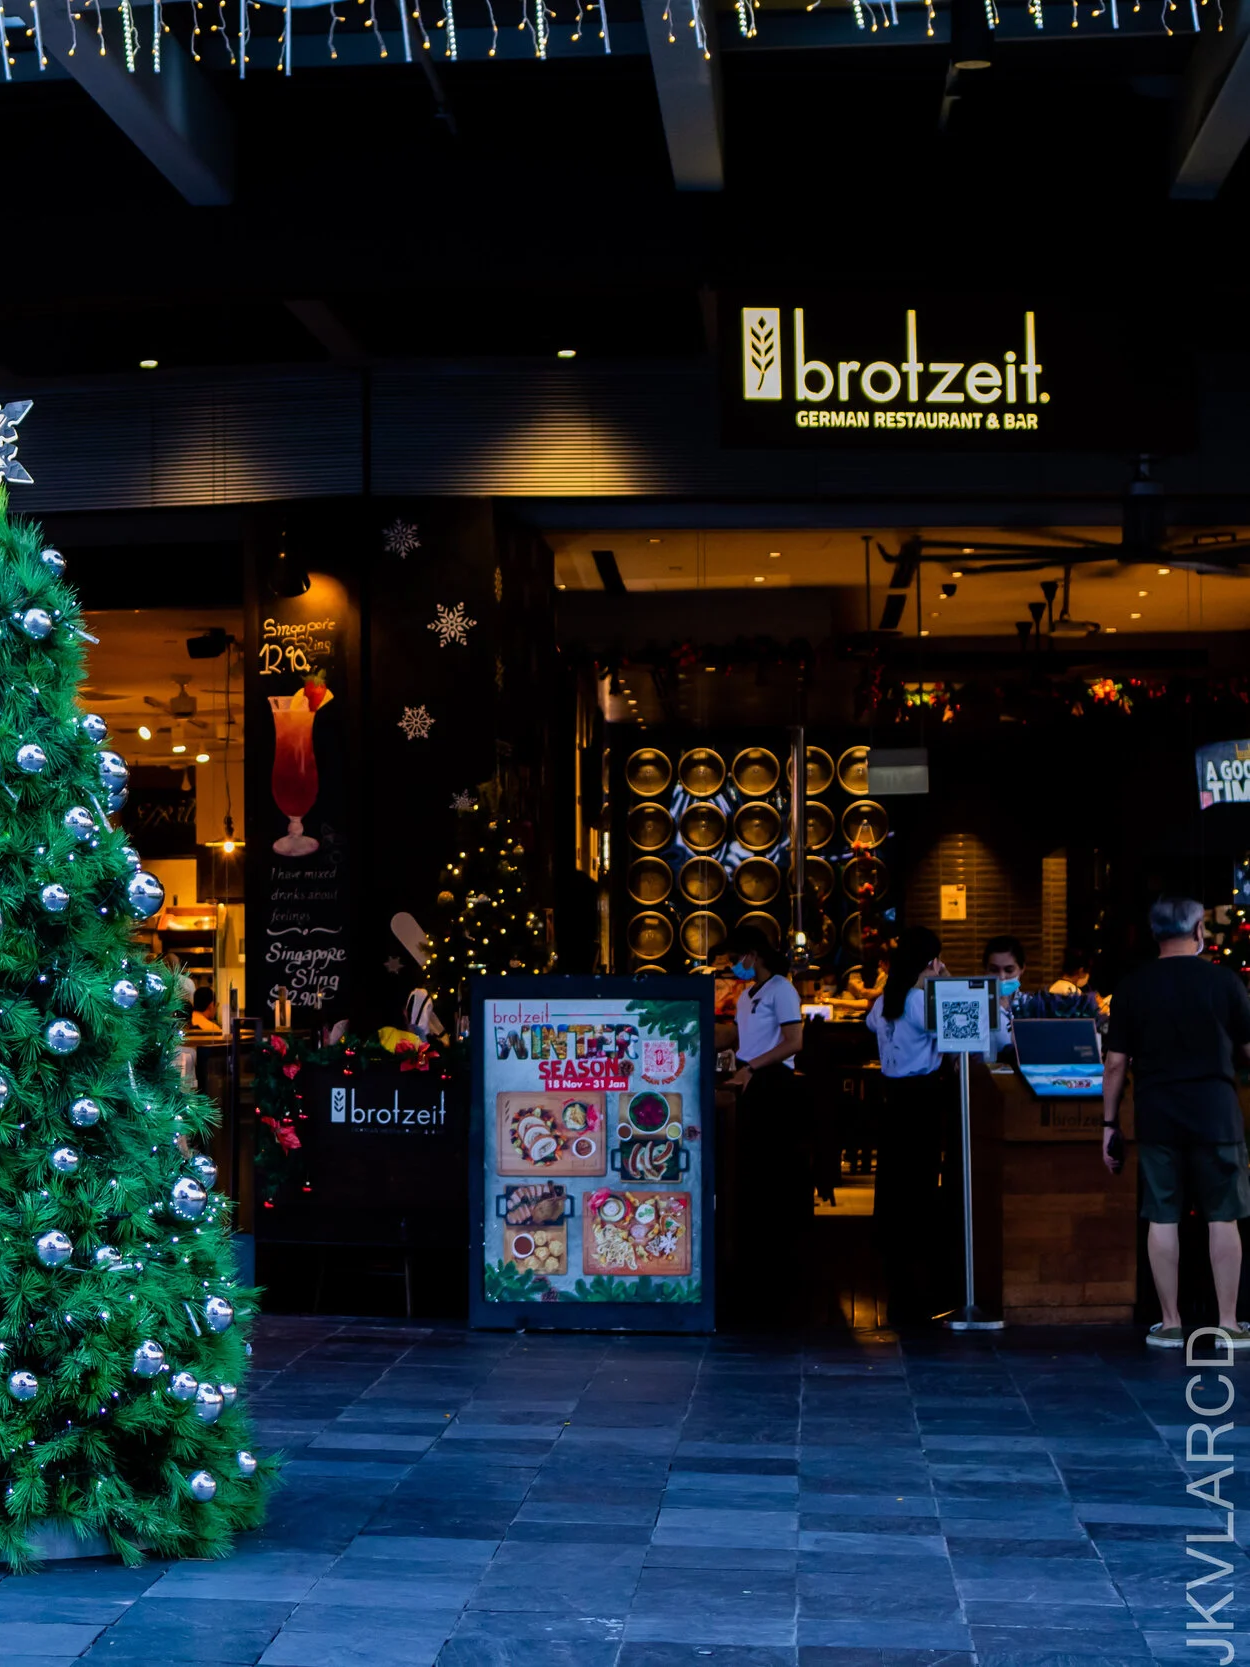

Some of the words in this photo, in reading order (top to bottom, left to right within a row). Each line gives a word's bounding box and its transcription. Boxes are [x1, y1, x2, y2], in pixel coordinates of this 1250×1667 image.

[796, 411, 869, 428] GERMAN
[874, 412, 983, 429] RESTAURANT
[986, 413, 1000, 429] &
[1003, 413, 1038, 430] BAR
[1207, 760, 1218, 781] A
[304, 866, 338, 880] mixed
[291, 969, 340, 1000] Sling
[494, 1023, 640, 1061] WINTER
[538, 1059, 618, 1080] SEASON
[548, 1080, 560, 1089] 18
[563, 1080, 583, 1089] Nov
[593, 1080, 605, 1089] 31
[609, 1080, 626, 1089] Jan
[350, 1087, 447, 1126] brotzeit
